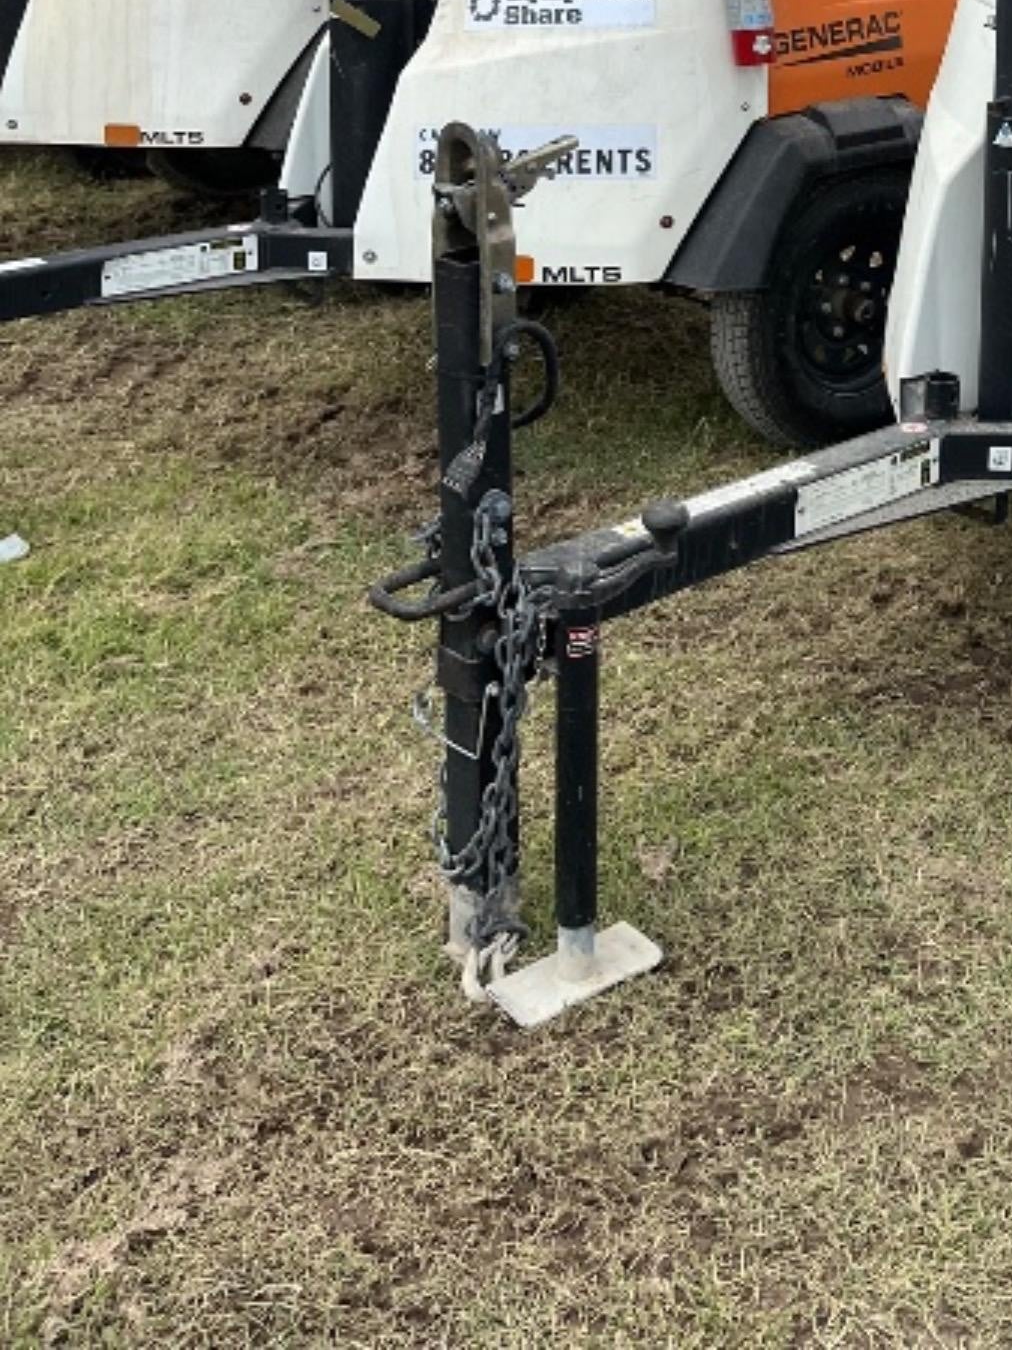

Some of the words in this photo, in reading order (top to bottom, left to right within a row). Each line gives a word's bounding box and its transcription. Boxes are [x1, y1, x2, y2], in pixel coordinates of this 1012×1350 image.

[504, 6, 583, 25] Share
[774, 11, 901, 54] GENERAC
[542, 266, 622, 283] MLTS
